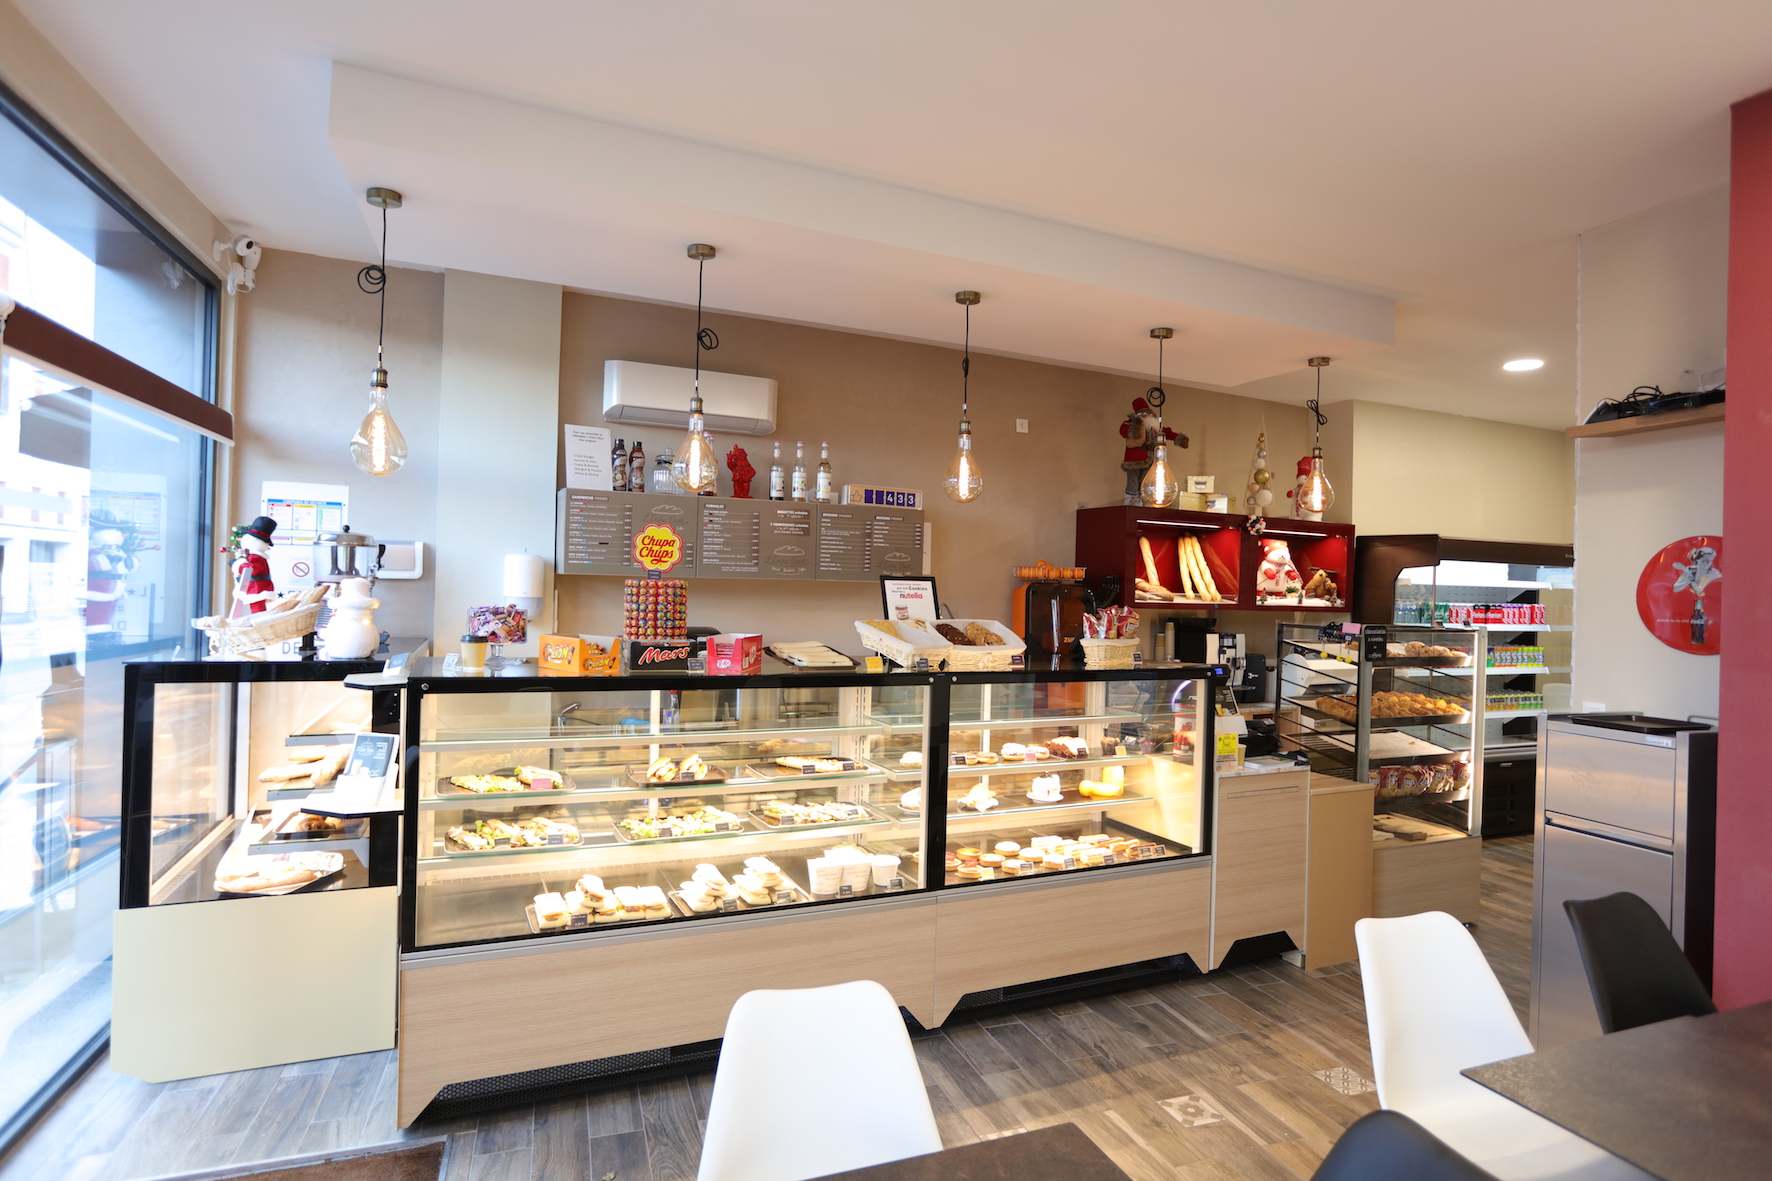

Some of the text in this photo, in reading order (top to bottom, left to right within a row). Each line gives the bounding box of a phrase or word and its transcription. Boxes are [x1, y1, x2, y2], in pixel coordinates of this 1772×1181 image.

[641, 535, 677, 549] Chupa
[639, 546, 675, 565] Chups
[637, 646, 691, 666] Mars
